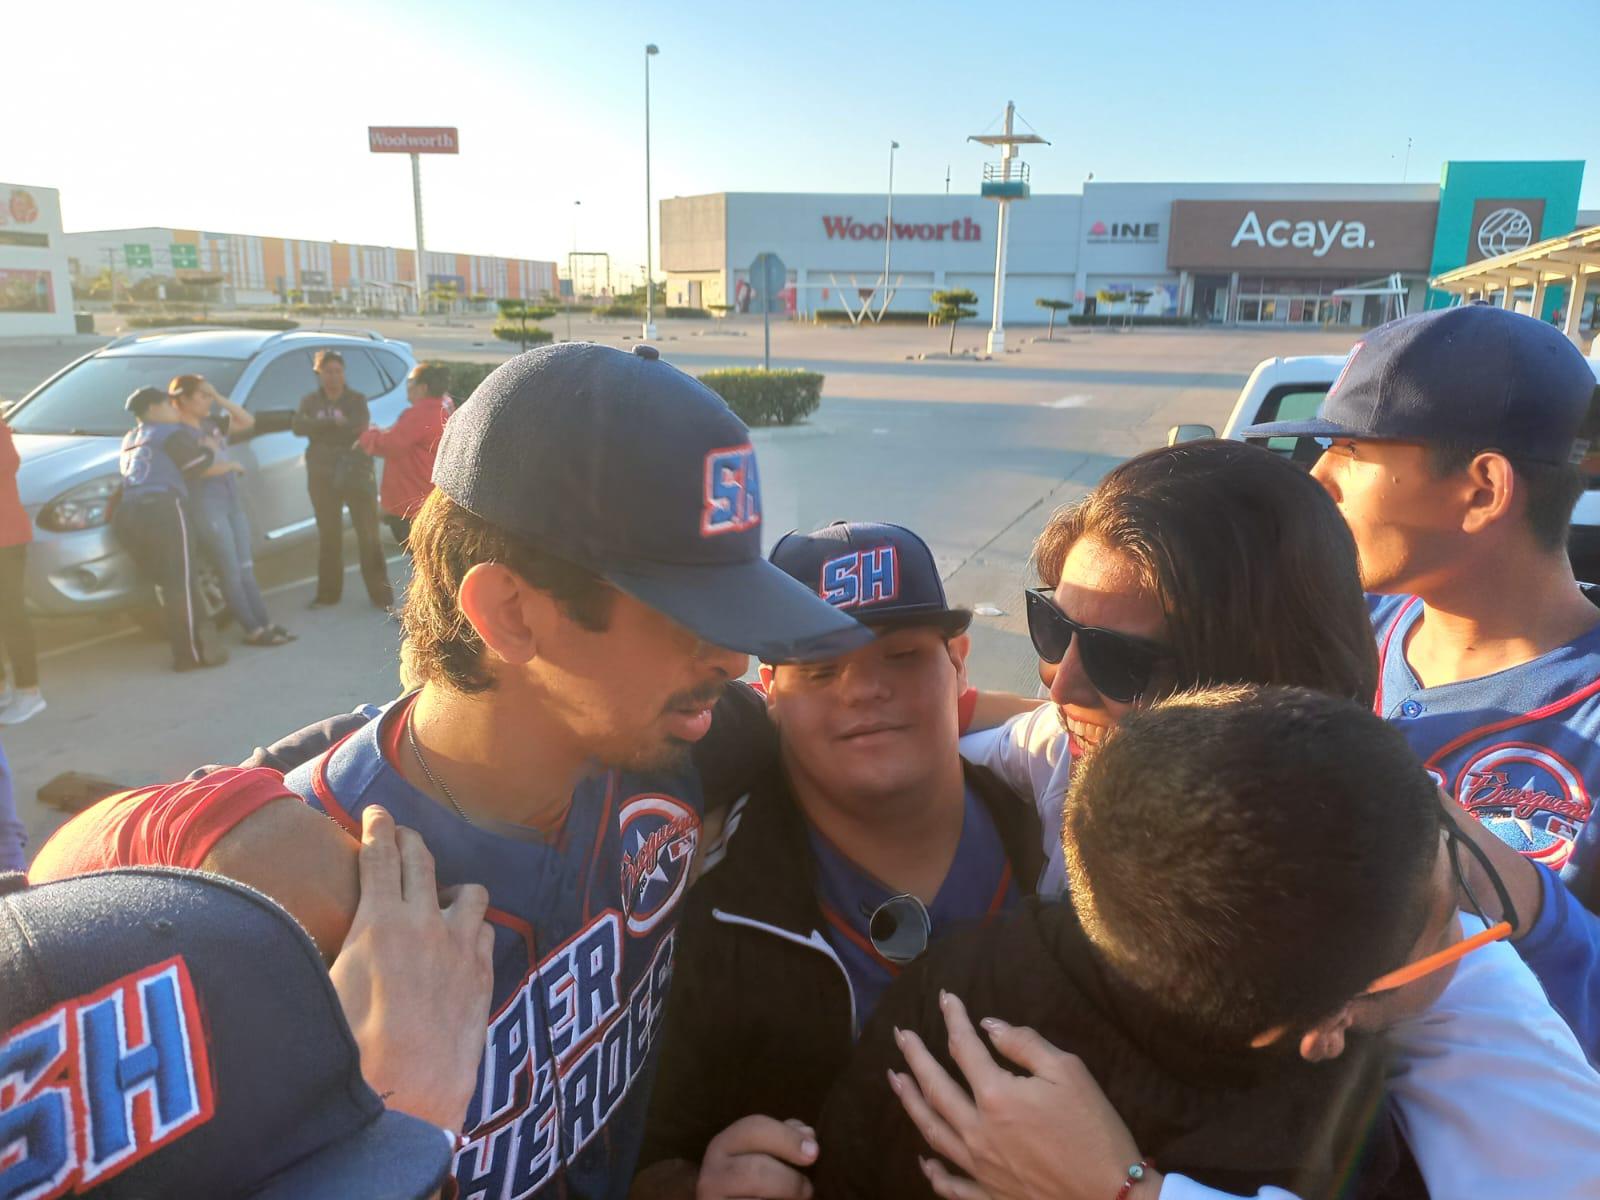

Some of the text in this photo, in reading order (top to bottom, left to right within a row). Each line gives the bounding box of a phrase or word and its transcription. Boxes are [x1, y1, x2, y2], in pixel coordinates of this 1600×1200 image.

[371, 131, 453, 148] Woolworth
[1111, 222, 1160, 238] INE
[1231, 210, 1376, 257] Acaya.
[821, 546, 898, 607] SH
[467, 912, 624, 1133] PER
[0, 959, 209, 1200] SH
